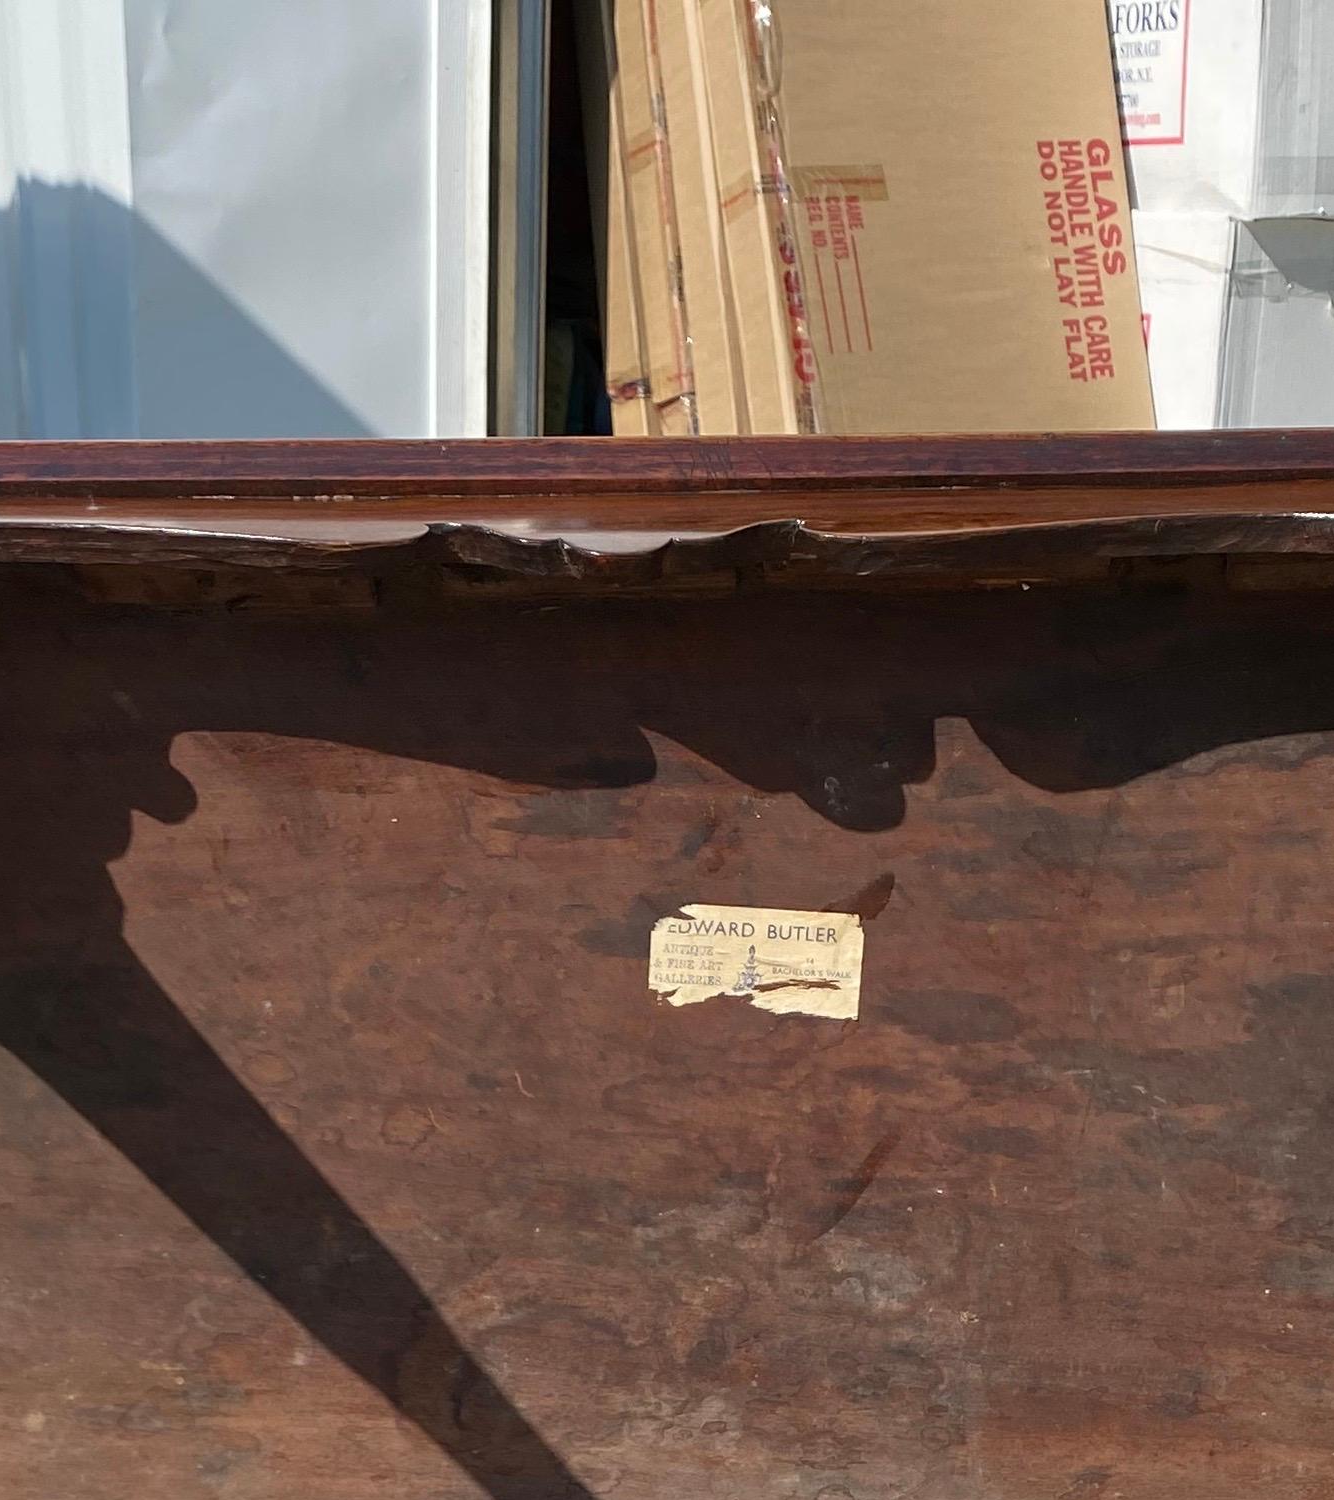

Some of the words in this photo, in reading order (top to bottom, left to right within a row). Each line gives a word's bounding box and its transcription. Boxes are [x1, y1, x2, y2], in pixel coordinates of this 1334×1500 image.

[1115, 0, 1180, 34] FORKS
[1036, 140, 1058, 181] DO
[1058, 139, 1094, 238] HANDLE
[1086, 138, 1127, 276] GLASS
[825, 195, 849, 260] CONTENTS
[845, 195, 865, 230] NAME
[1043, 191, 1068, 247] NOT
[1053, 257, 1078, 309] LAY
[1073, 244, 1105, 308] WITH
[1062, 318, 1088, 382] FLAT
[1083, 314, 1114, 381] CARE
[663, 944, 715, 957] ANTIQUE
[667, 919, 755, 938] EDWARD
[767, 924, 838, 943] BUTLER
[653, 958, 663, 969] &
[667, 958, 695, 970] FINE
[699, 960, 724, 972] ART
[654, 972, 722, 986] GALLERIES
[826, 969, 852, 979] WALK
